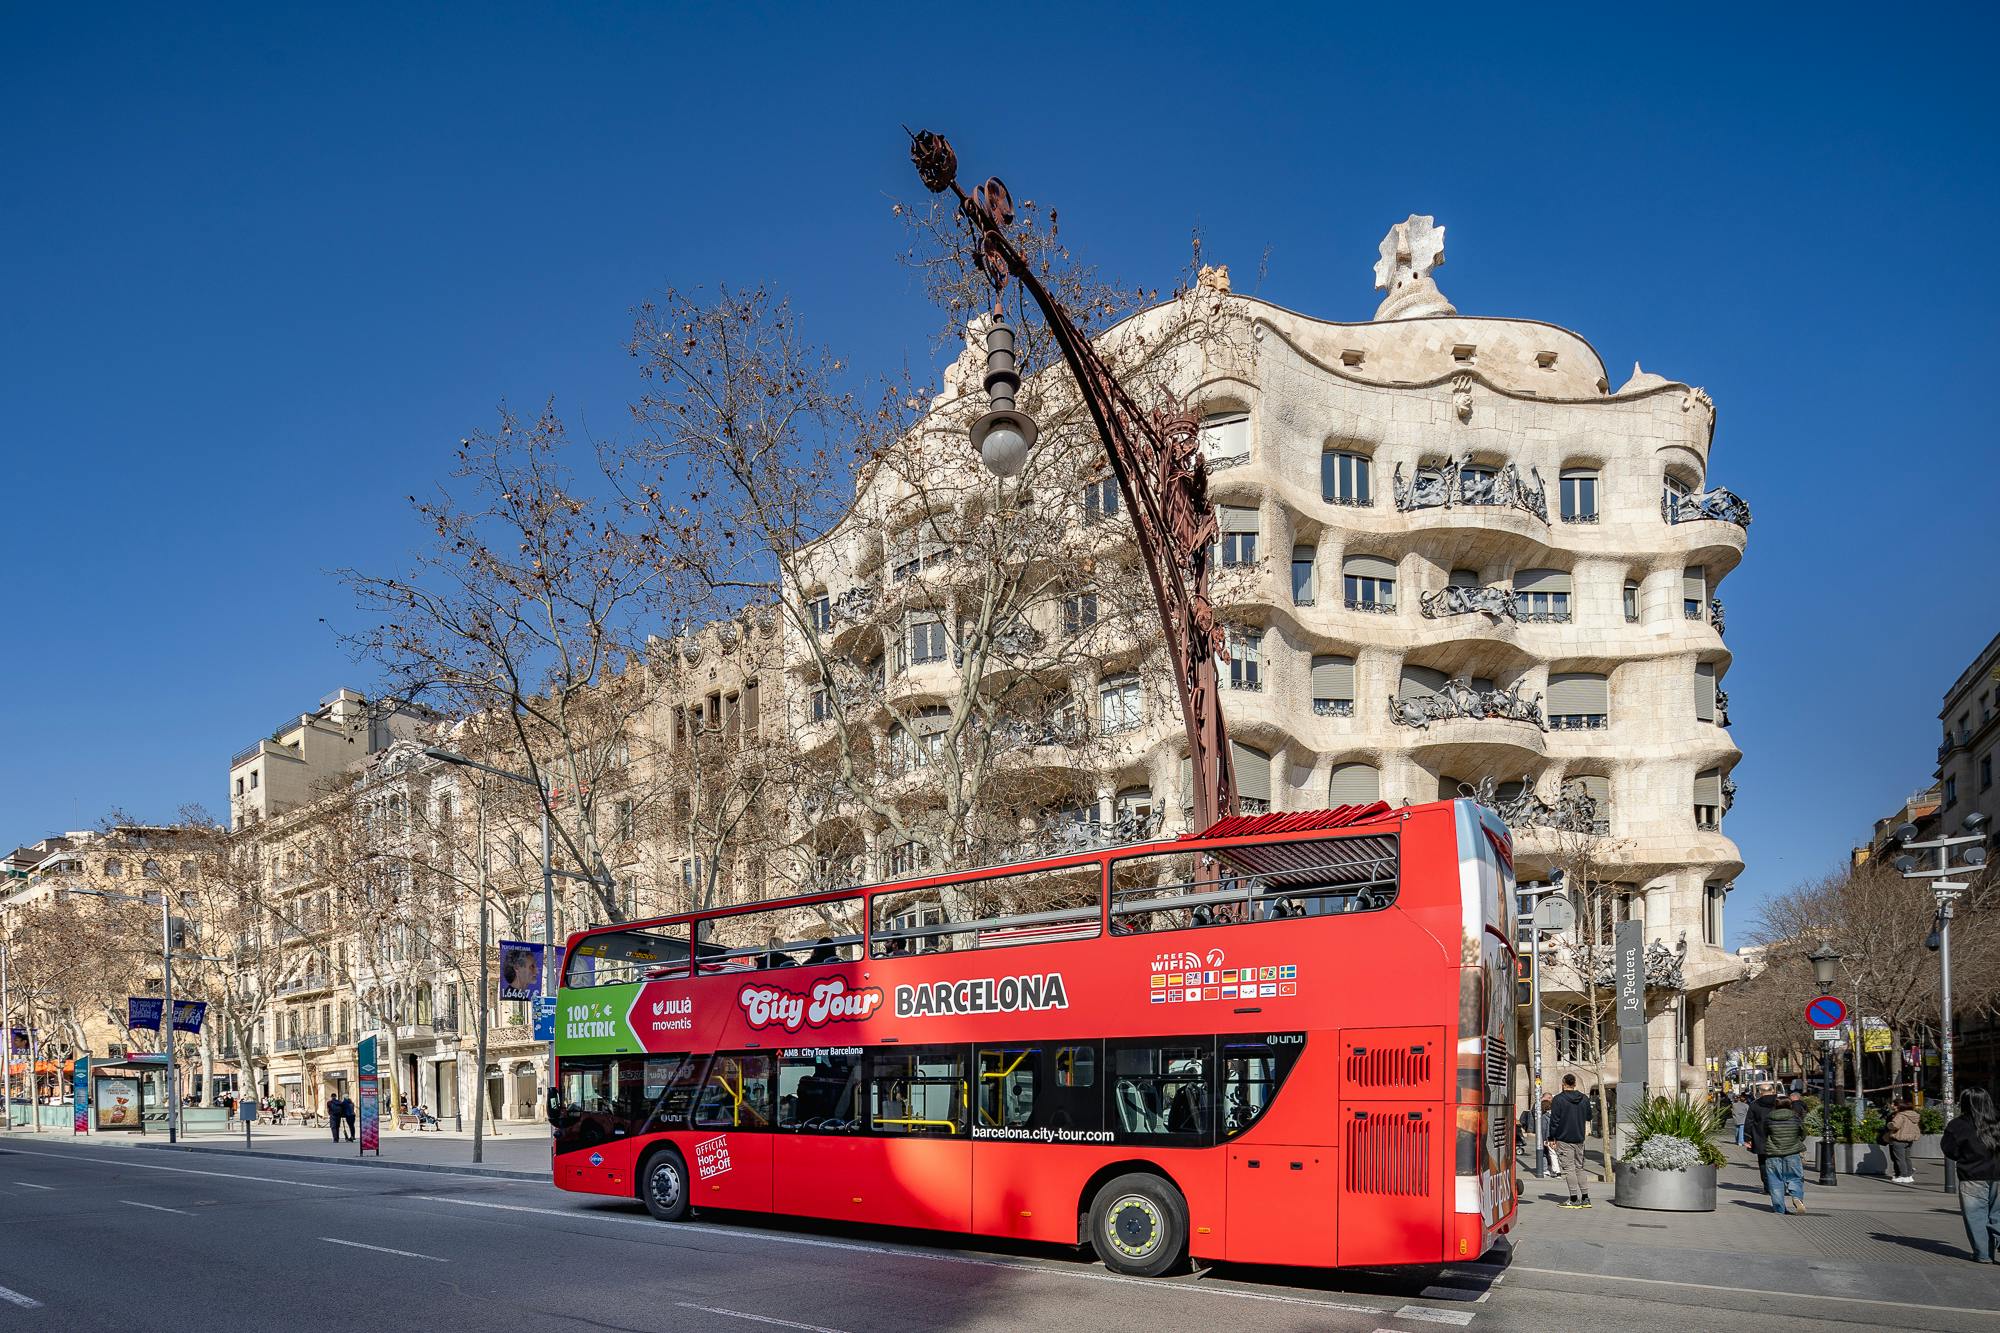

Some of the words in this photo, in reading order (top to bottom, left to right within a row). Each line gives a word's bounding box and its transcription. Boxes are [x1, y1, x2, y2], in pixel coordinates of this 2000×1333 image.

[1156, 952, 1183, 960] FREE
[1151, 960, 1183, 971] WIFI
[1623, 948, 1636, 998] Pedrera
[502, 988, 530, 1000] 1.646,7
[896, 974, 1068, 1017] BARCELONA
[741, 988, 804, 1028] City
[808, 980, 879, 1023] Tour
[1623, 998, 1639, 1011] La
[567, 1004, 589, 1022] 100
[567, 1020, 616, 1039] ELECTRIC
[652, 1017, 692, 1031] moventis
[784, 1049, 798, 1057] AMB
[801, 1048, 814, 1058] City
[815, 1048, 829, 1056] Tour
[830, 1046, 863, 1056] Barcelona
[972, 1126, 1114, 1143] barcelona.city-tour.com
[696, 1138, 727, 1156] OFFICIAL
[698, 1149, 728, 1166] Hop-On
[700, 1157, 730, 1177] Hop-Off
